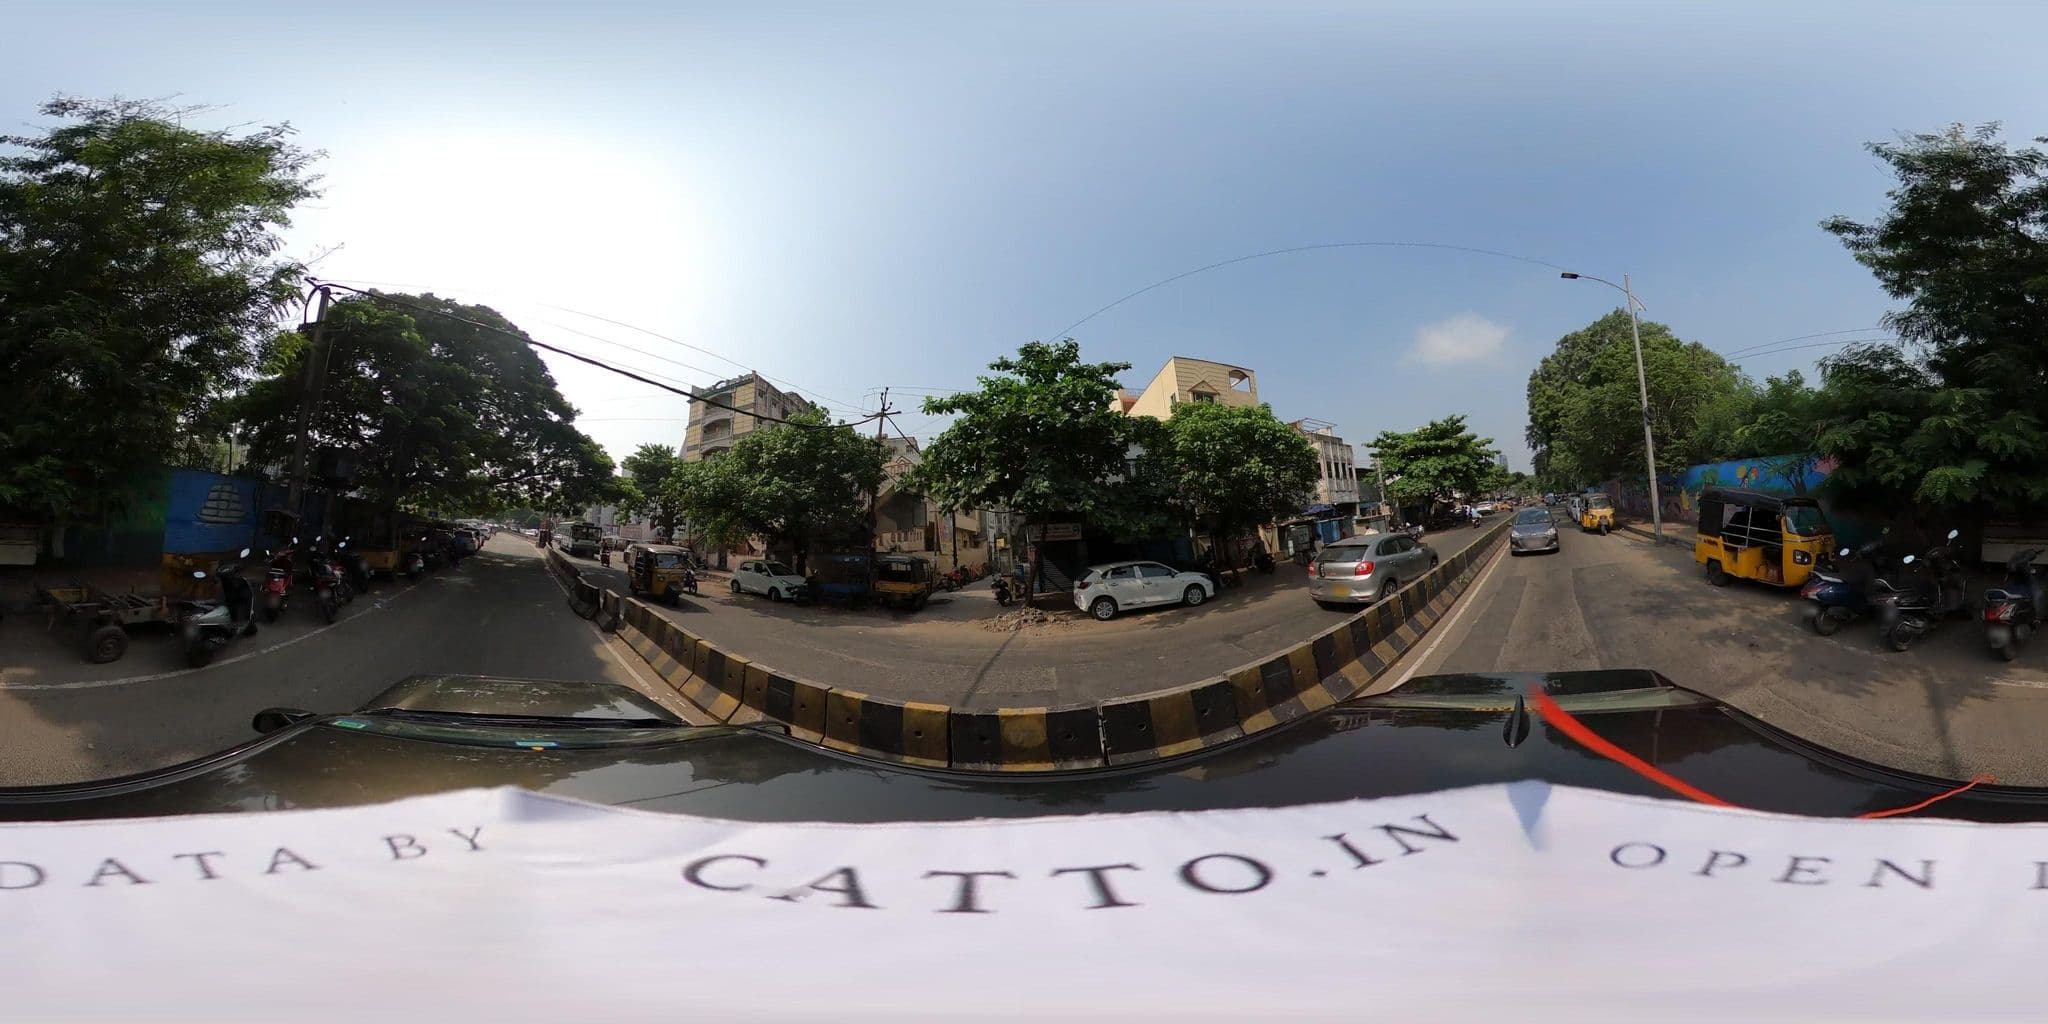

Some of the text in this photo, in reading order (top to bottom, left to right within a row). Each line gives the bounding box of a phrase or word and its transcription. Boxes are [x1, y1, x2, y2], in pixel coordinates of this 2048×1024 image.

[380, 826, 486, 861] BY
[681, 812, 1461, 915] CATTO.IN
[1608, 842, 1937, 890] OPEN
